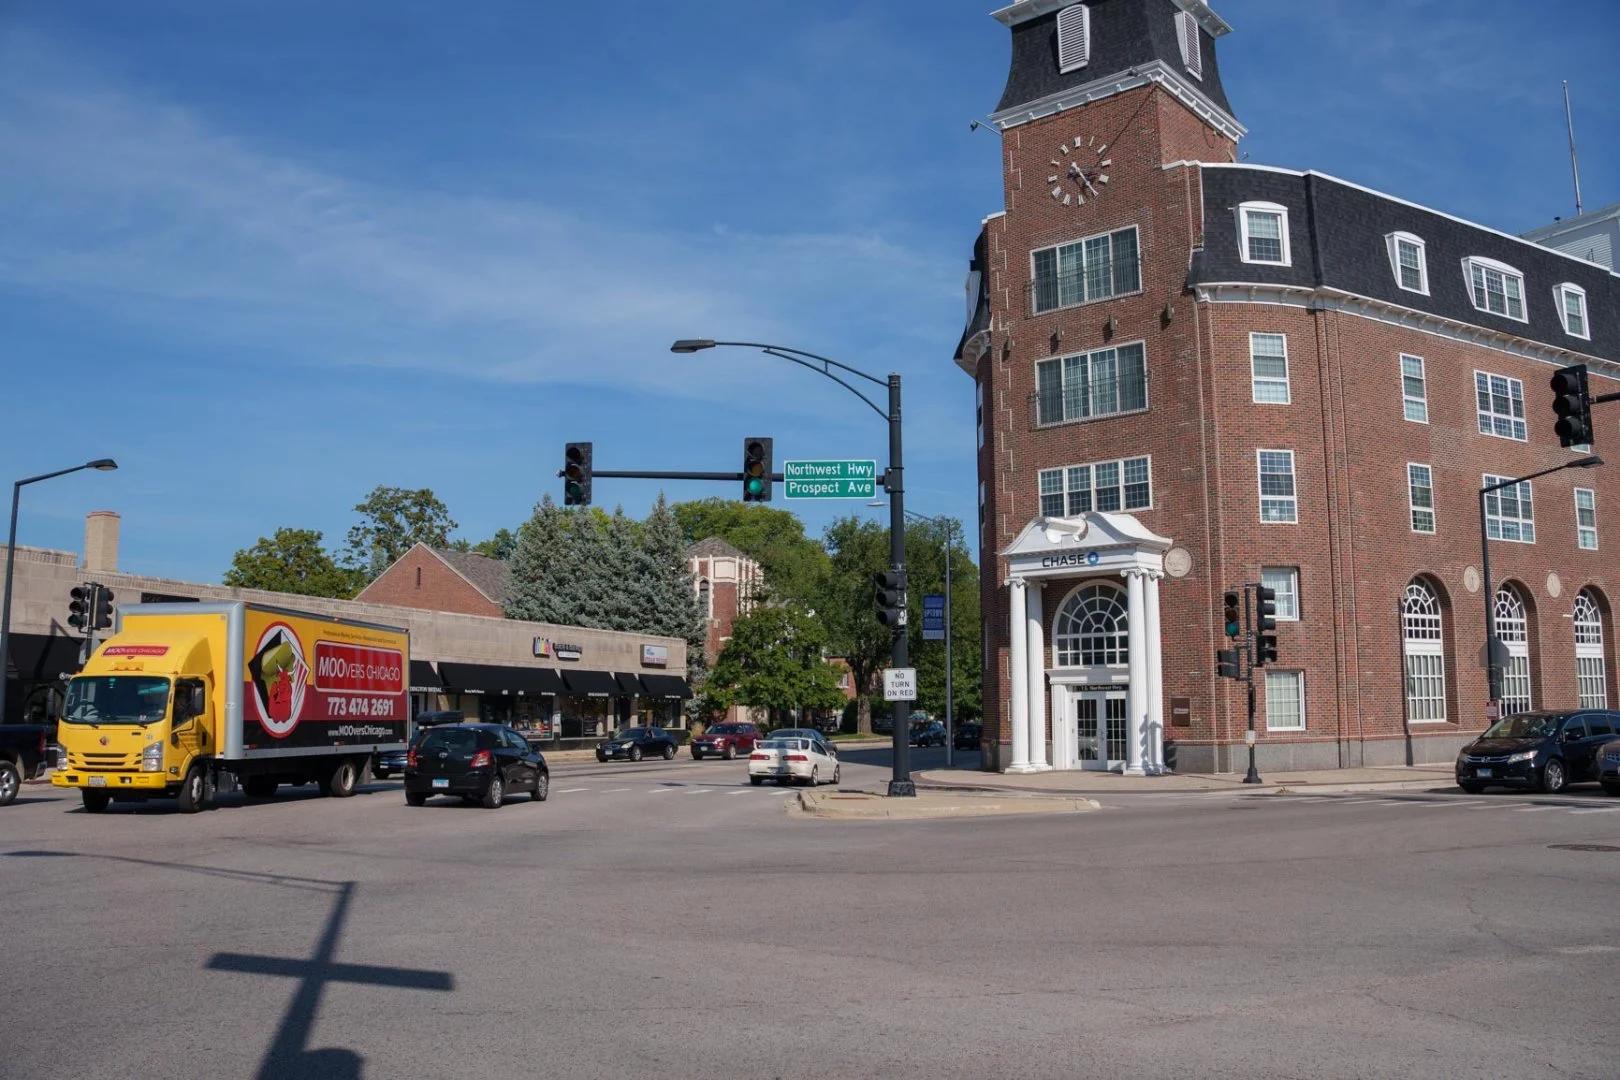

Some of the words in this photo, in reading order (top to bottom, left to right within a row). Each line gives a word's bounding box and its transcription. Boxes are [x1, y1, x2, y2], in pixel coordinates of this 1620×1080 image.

[787, 463, 841, 476] Northwest
[847, 463, 873, 477] Hwy
[789, 481, 840, 495] Prospect
[847, 482, 871, 493] Ave
[1042, 553, 1085, 568] CHASE
[366, 664, 401, 681] CHICAGO
[327, 697, 347, 716] 773
[348, 697, 369, 716] 474
[370, 698, 394, 716] 2691
